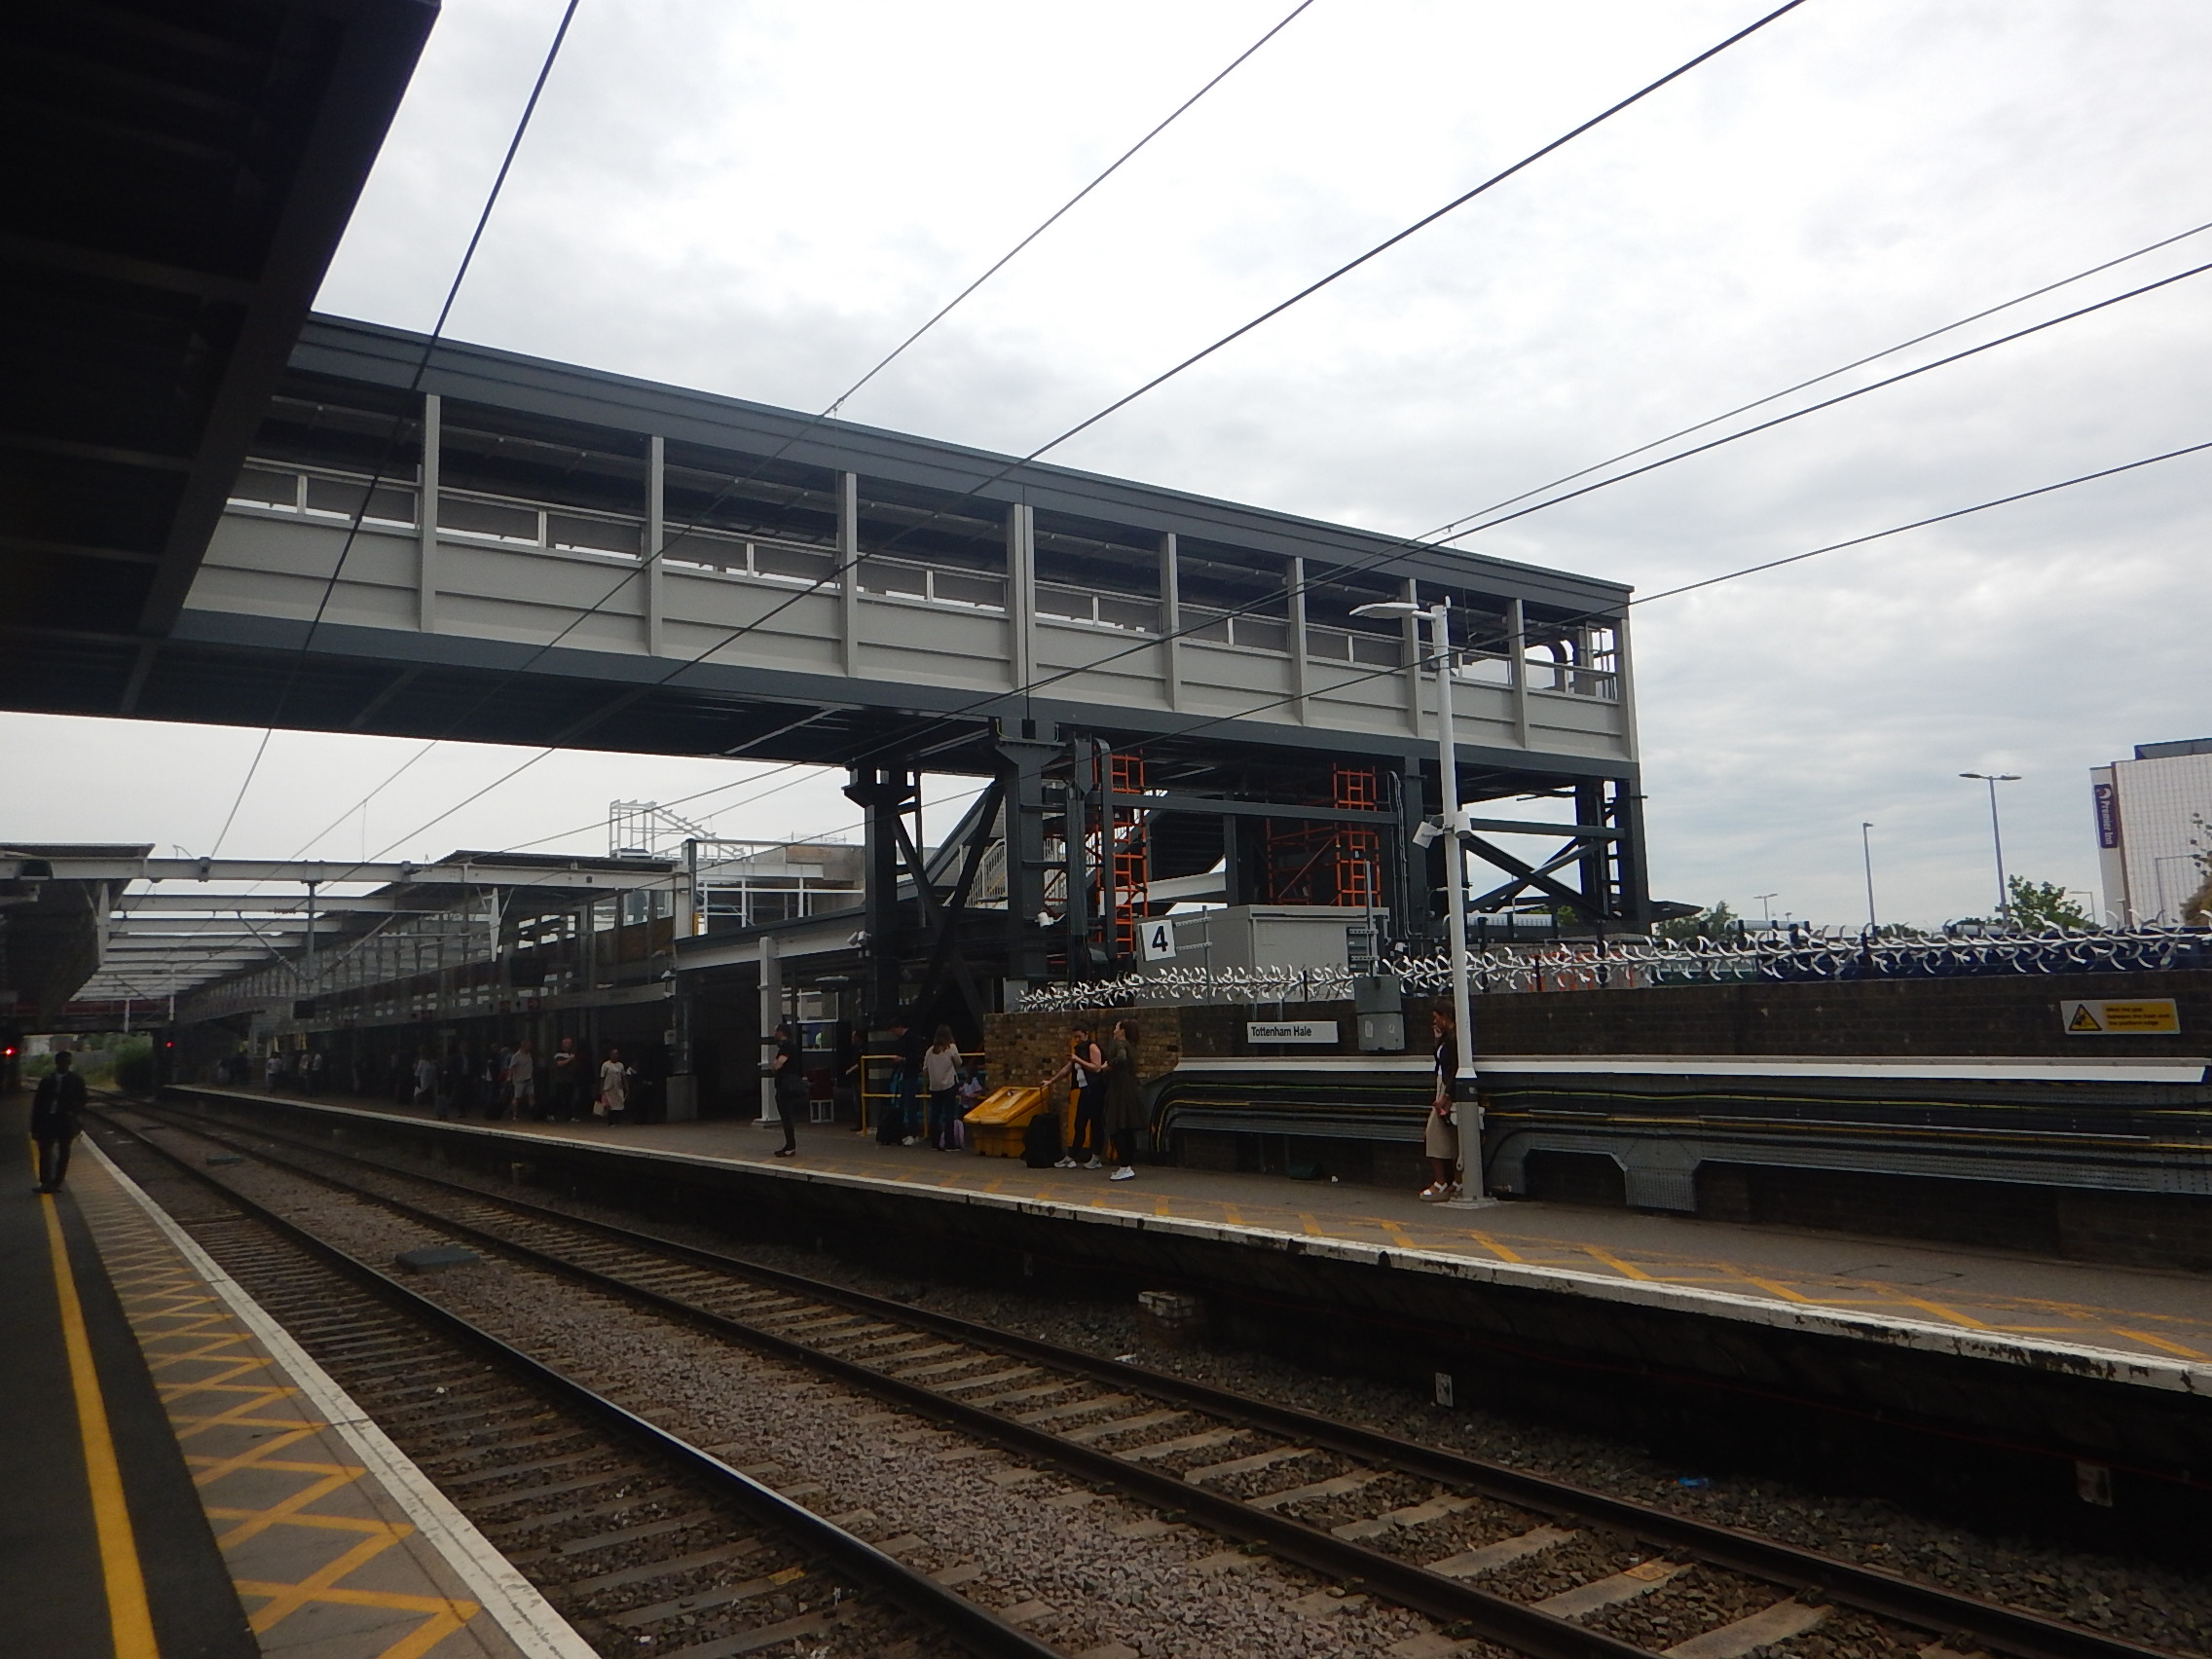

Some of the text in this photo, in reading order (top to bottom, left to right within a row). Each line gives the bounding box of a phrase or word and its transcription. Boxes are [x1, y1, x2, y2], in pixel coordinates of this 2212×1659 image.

[2104, 831, 2114, 845] Inn
[1152, 925, 1168, 952] 4
[1250, 1025, 1312, 1037] Tottenham Hale
